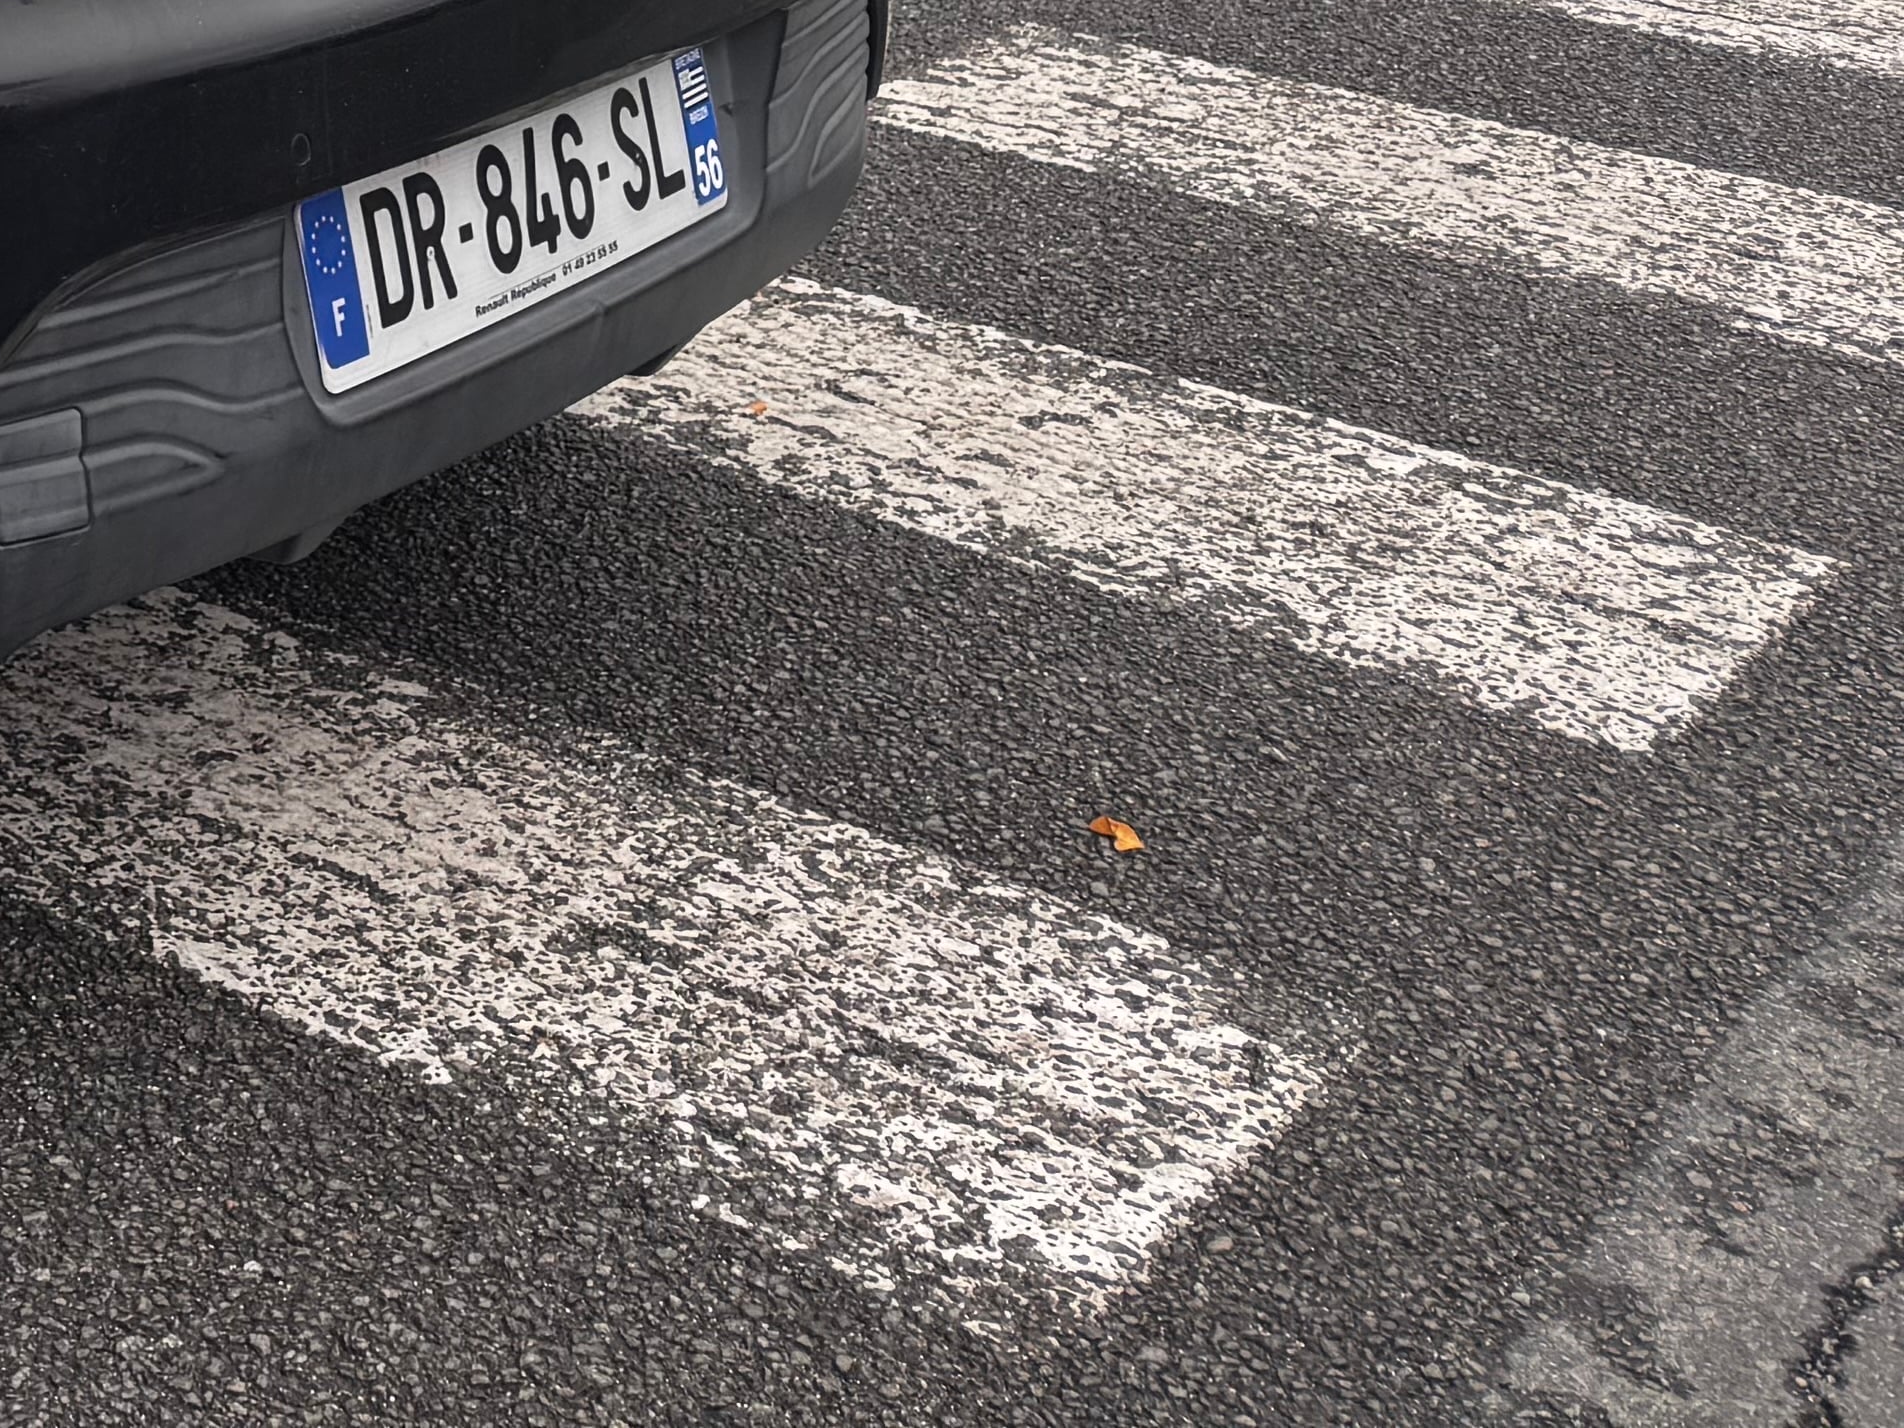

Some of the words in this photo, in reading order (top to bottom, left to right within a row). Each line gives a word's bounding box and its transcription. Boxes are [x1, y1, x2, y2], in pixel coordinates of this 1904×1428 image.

[694, 138, 724, 197] 56
[359, 77, 687, 329] DR-846-SL
[331, 297, 347, 338] F
